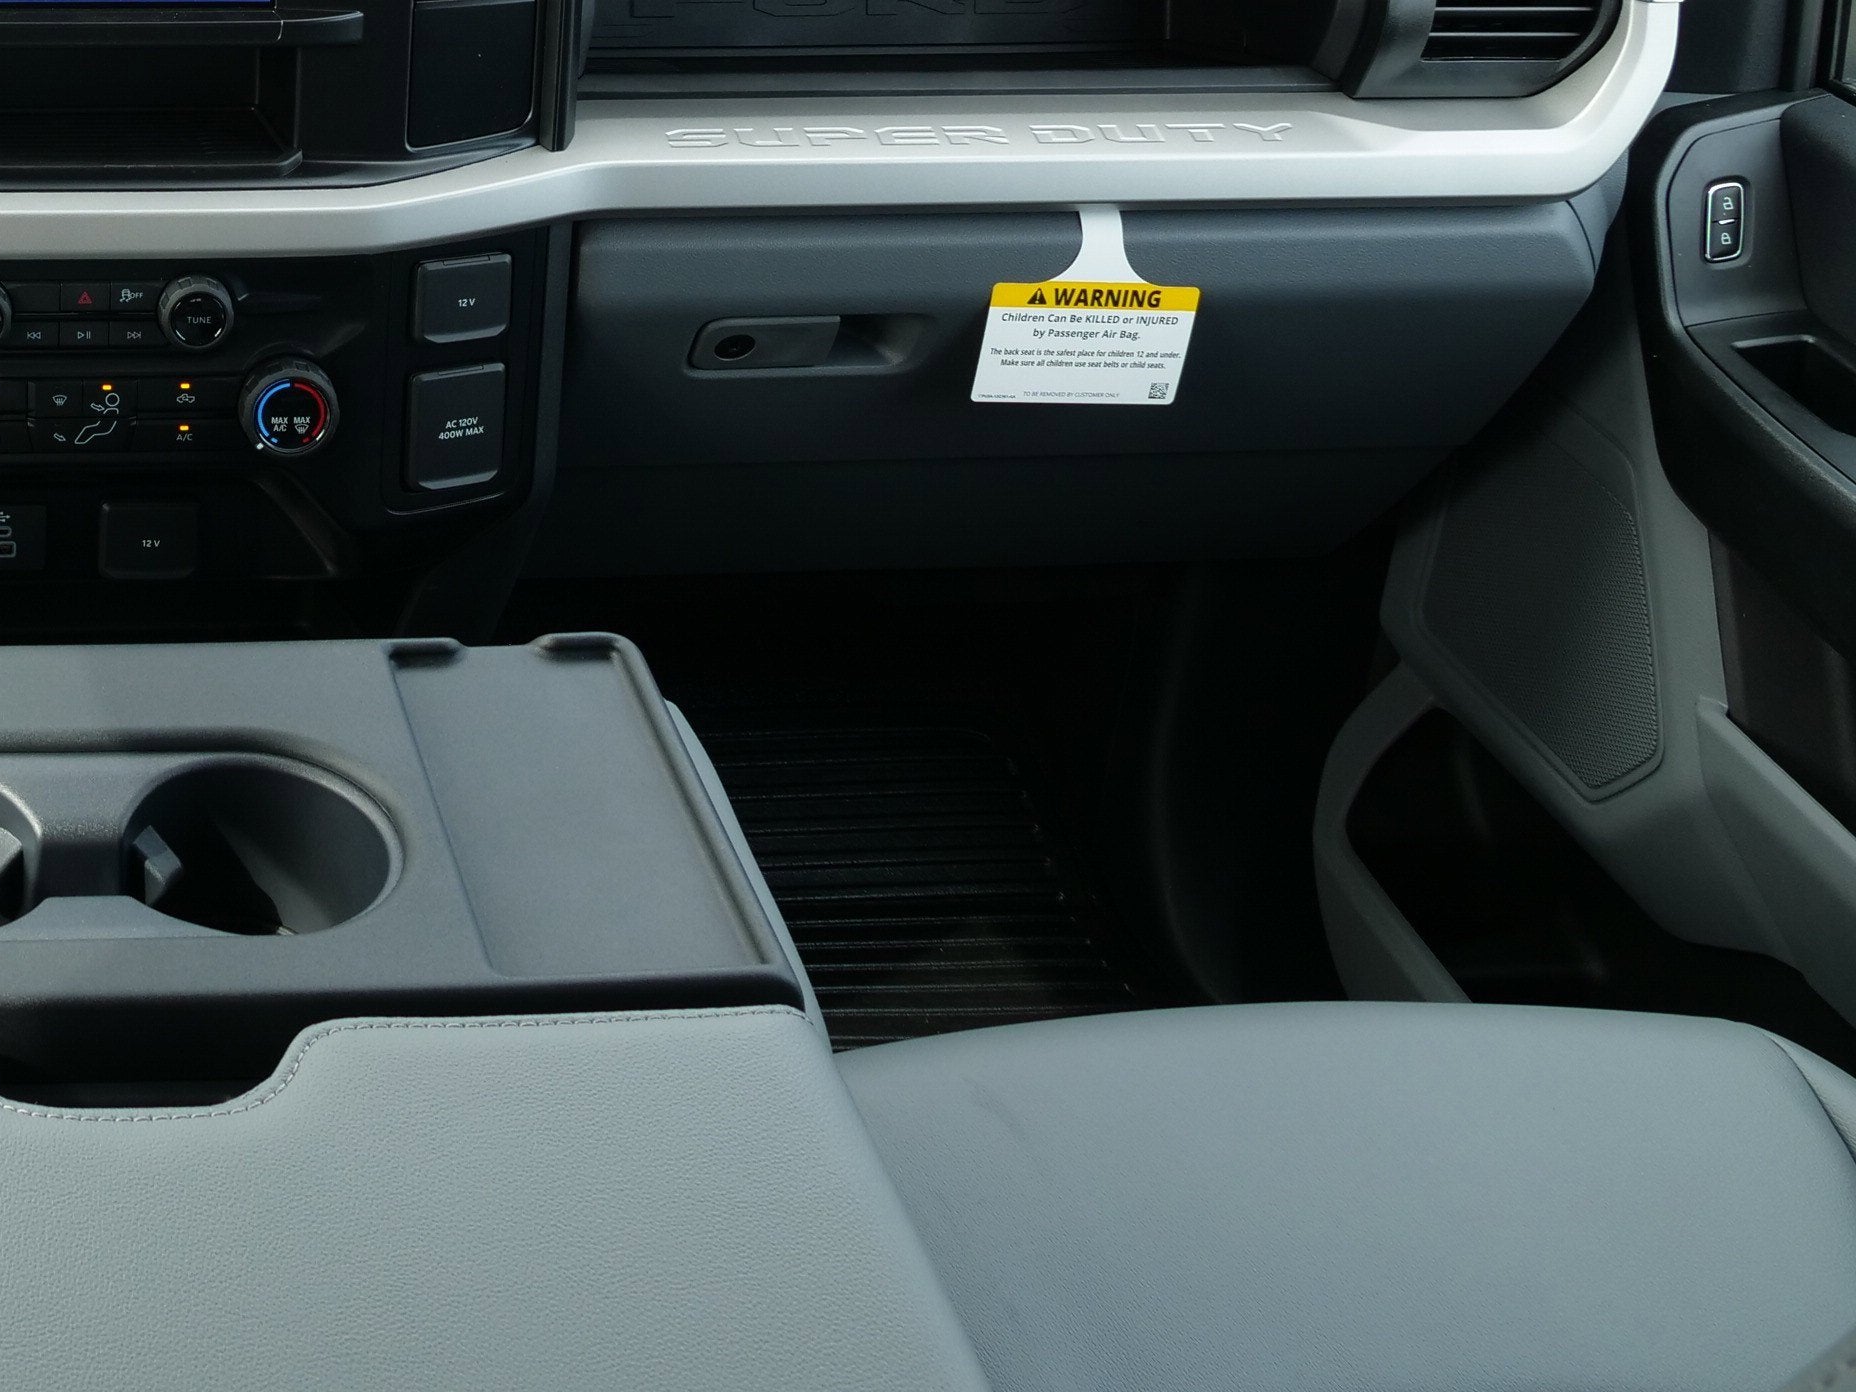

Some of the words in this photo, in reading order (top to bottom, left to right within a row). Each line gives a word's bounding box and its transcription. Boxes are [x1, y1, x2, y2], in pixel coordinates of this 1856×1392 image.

[664, 124, 1011, 150] SUPER
[1028, 122, 1293, 146] DUTY
[1054, 288, 1162, 308] WARNING
[186, 316, 212, 324] TUNE
[1002, 313, 1044, 323] Children
[1048, 314, 1066, 323] Can
[1070, 314, 1082, 323] Be
[1085, 315, 1120, 325] KILLED
[1123, 317, 1132, 325] or
[1136, 316, 1178, 326] INJURED
[1033, 328, 1044, 338] by
[1048, 328, 1099, 339] Passenger
[1102, 330, 1117, 338] Air
[1120, 330, 1141, 341] Bag.
[990, 348, 1002, 356] The
[1004, 348, 1019, 356] back
[1056, 349, 1076, 357] safest
[1077, 350, 1095, 359] place
[1108, 350, 1134, 358] children
[1136, 350, 1144, 358] 12
[1145, 350, 1158, 358] and
[1000, 359, 1018, 367] Make
[1046, 360, 1073, 368] children
[1130, 361, 1145, 369] child
[271, 417, 288, 425] MAX
[293, 416, 311, 424] MAX
[445, 420, 457, 430] AC
[458, 416, 479, 428] 120V
[273, 425, 287, 433] A/C
[438, 428, 460, 441] 400W
[461, 426, 485, 438] MAX
[176, 433, 193, 442] A/C
